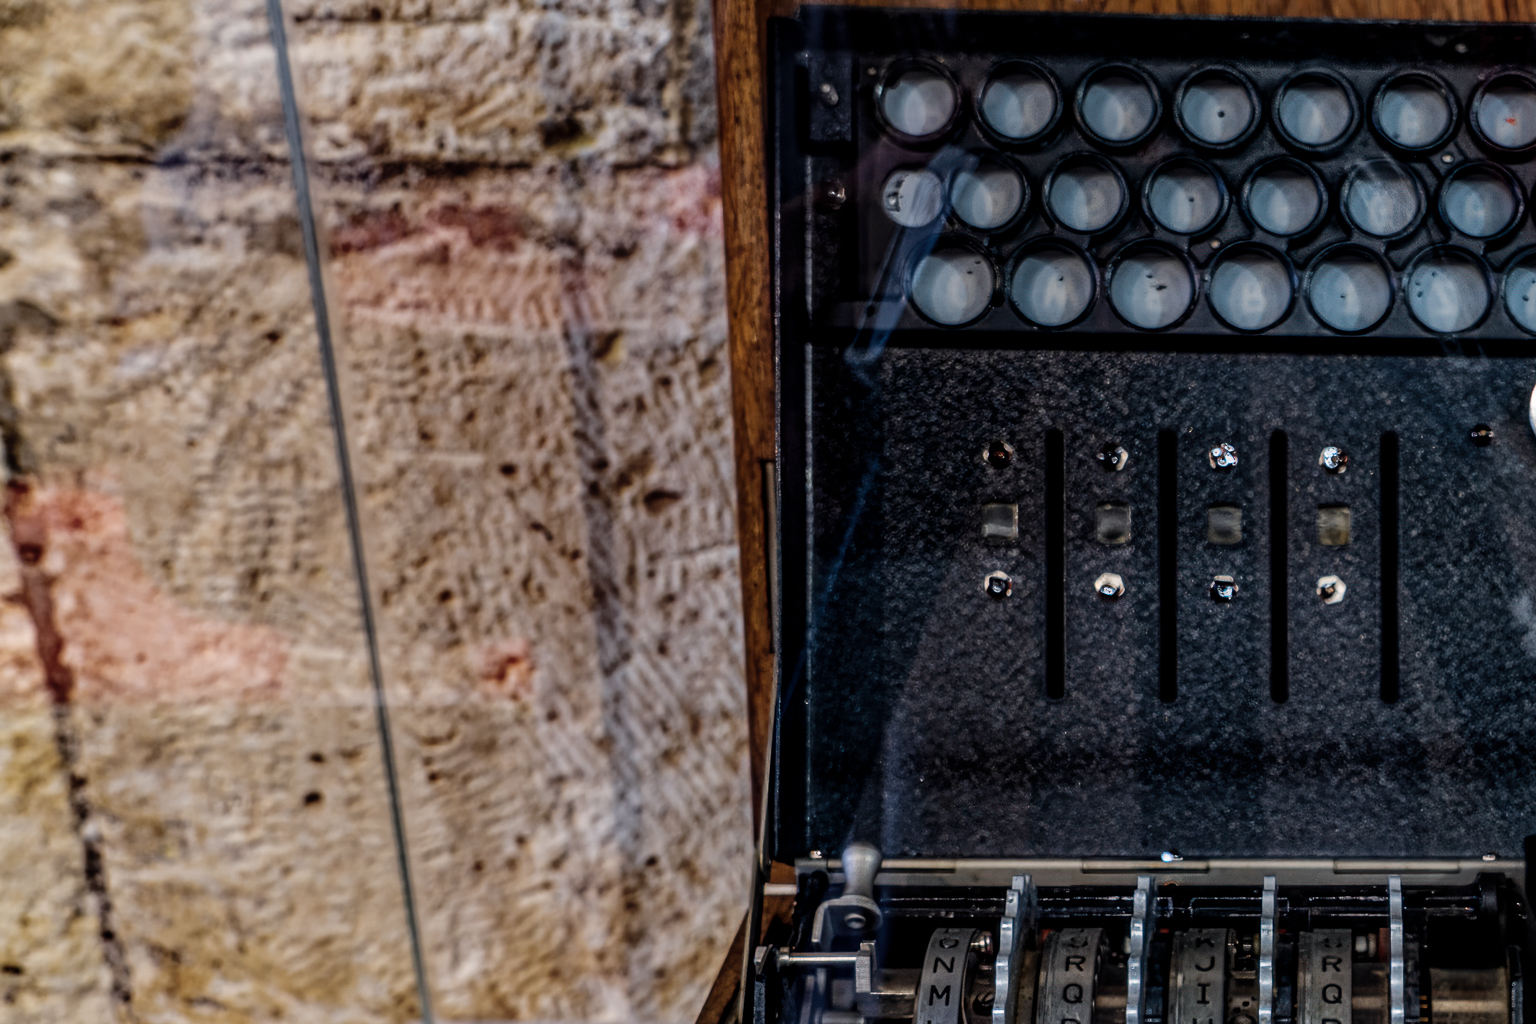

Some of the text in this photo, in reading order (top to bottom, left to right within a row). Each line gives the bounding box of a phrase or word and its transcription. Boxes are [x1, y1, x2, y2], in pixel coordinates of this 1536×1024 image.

[932, 956, 955, 974] N
[1064, 955, 1087, 972] R
[1195, 956, 1216, 972] J
[1321, 956, 1343, 972] R
[928, 984, 951, 1007] M
[1062, 983, 1083, 1004] Q
[1196, 982, 1211, 1005] I
[1321, 983, 1342, 1004] Q
